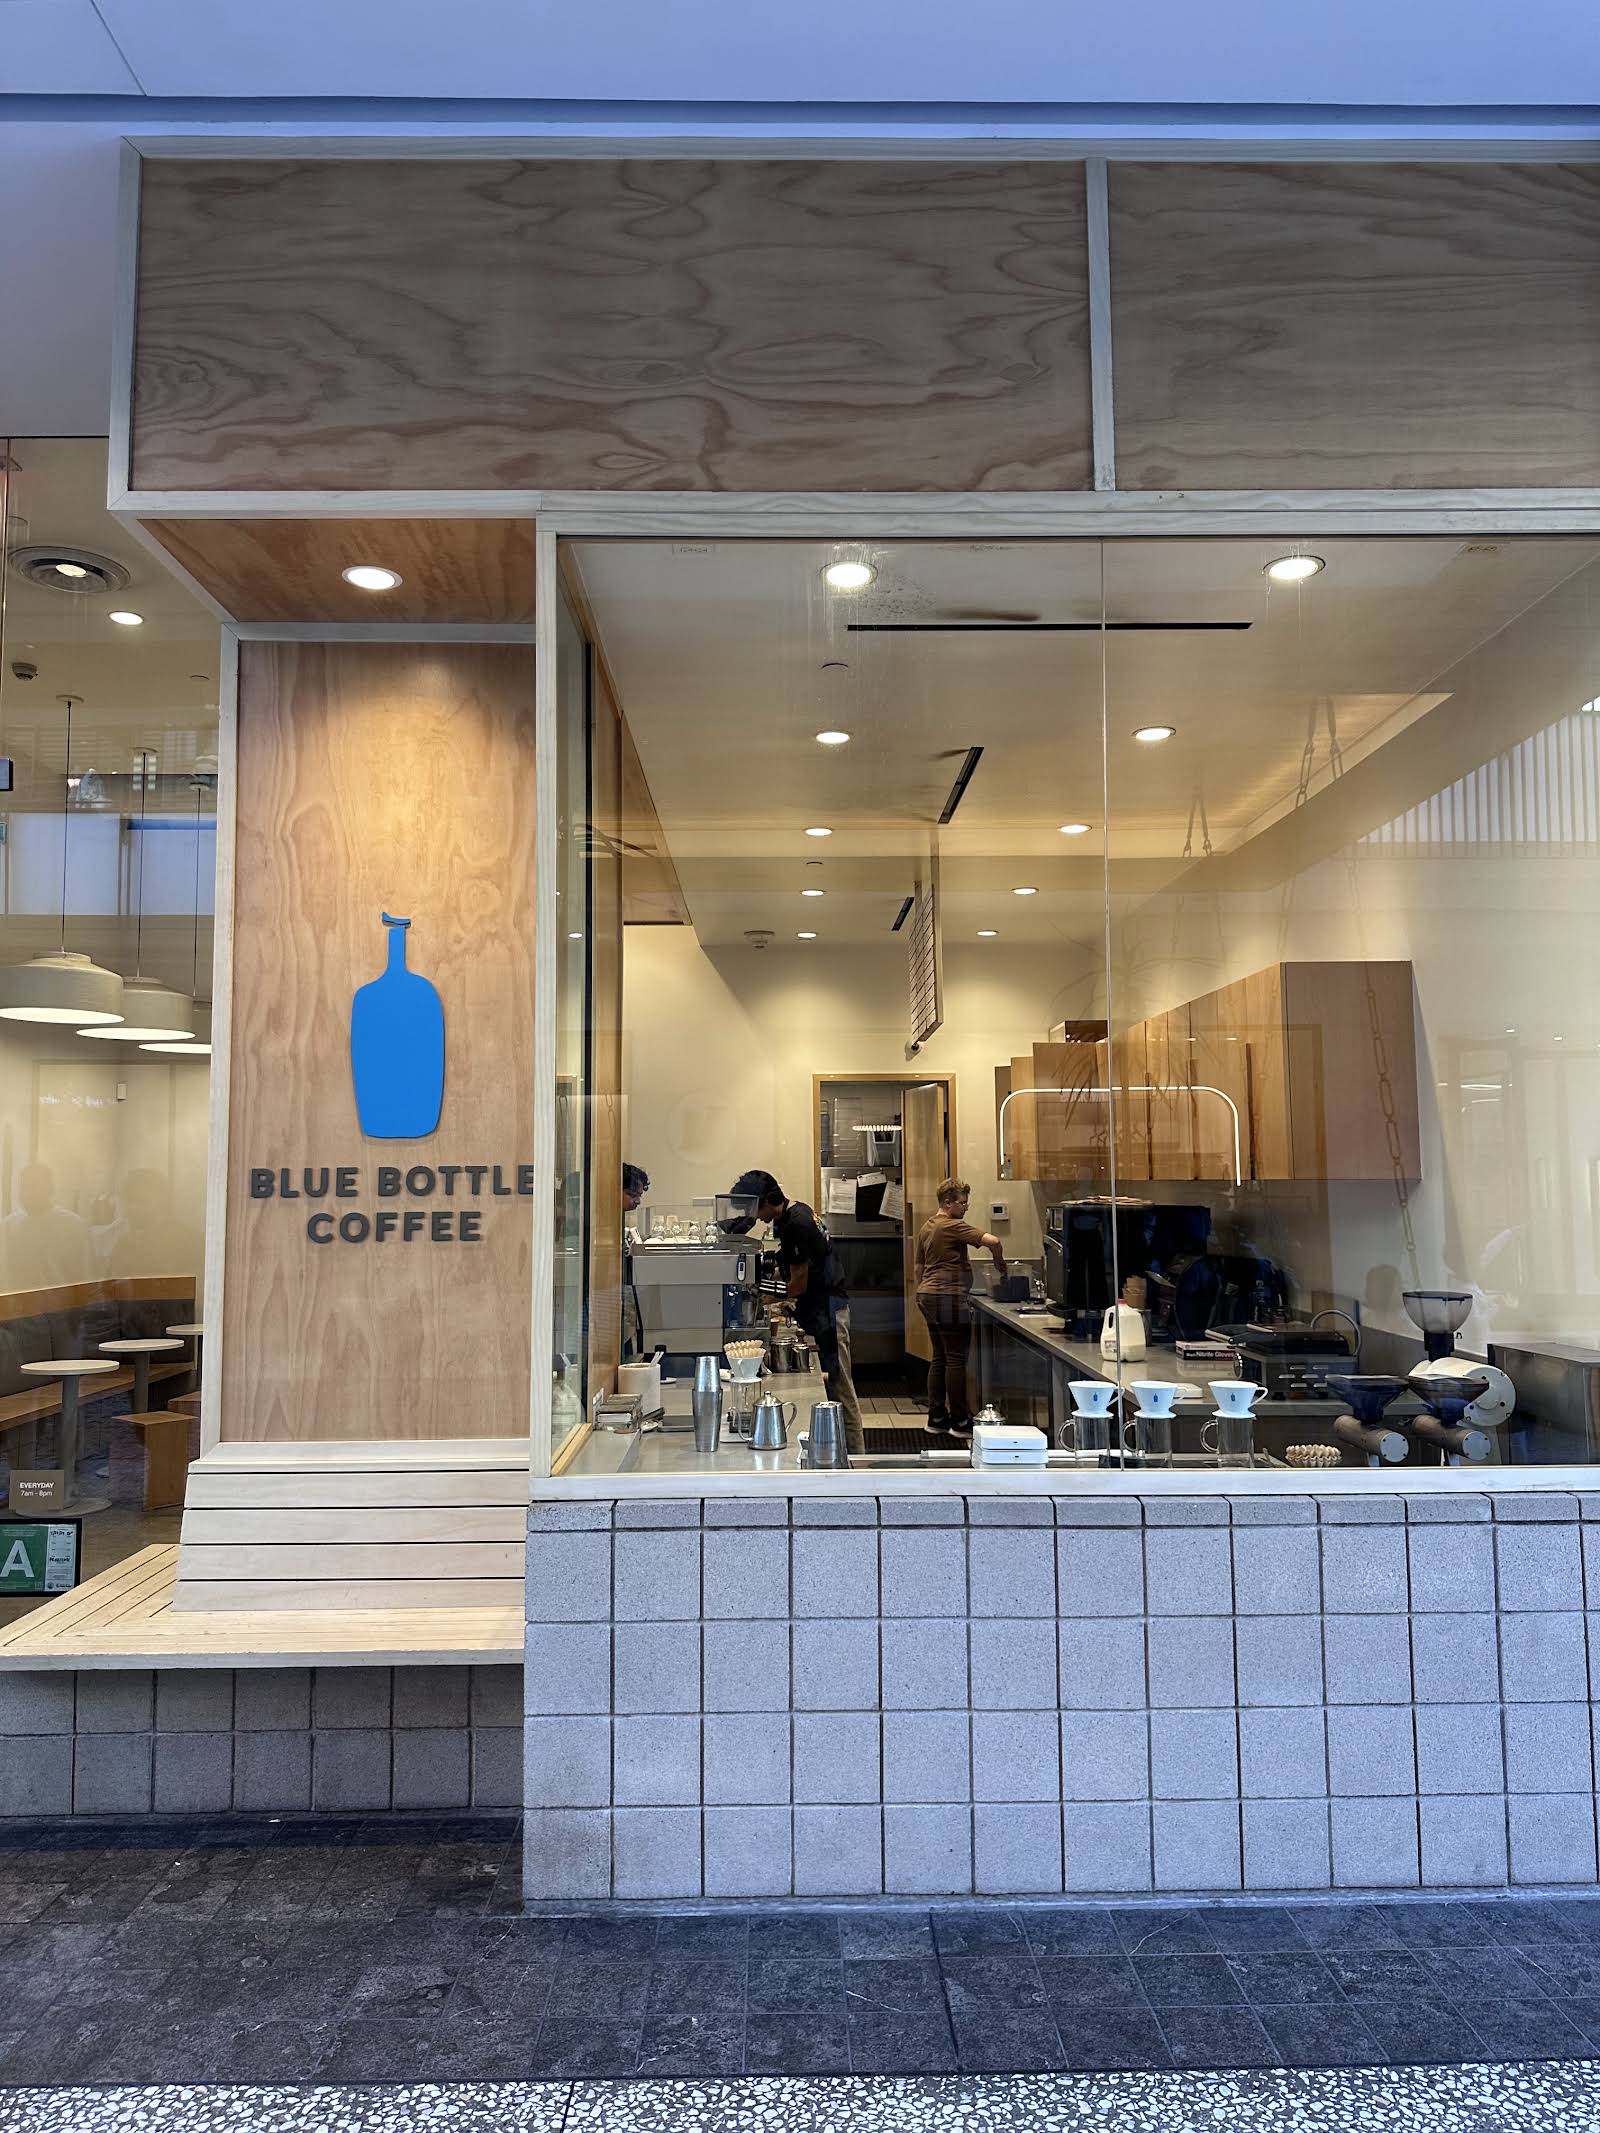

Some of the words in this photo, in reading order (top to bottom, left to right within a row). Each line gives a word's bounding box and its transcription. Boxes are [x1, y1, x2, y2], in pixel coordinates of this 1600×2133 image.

[250, 1167, 359, 1198] BLUE
[377, 1165, 534, 1197] BOTTLE
[307, 1211, 481, 1244] COFFEE
[0, 1540, 35, 1577] A
